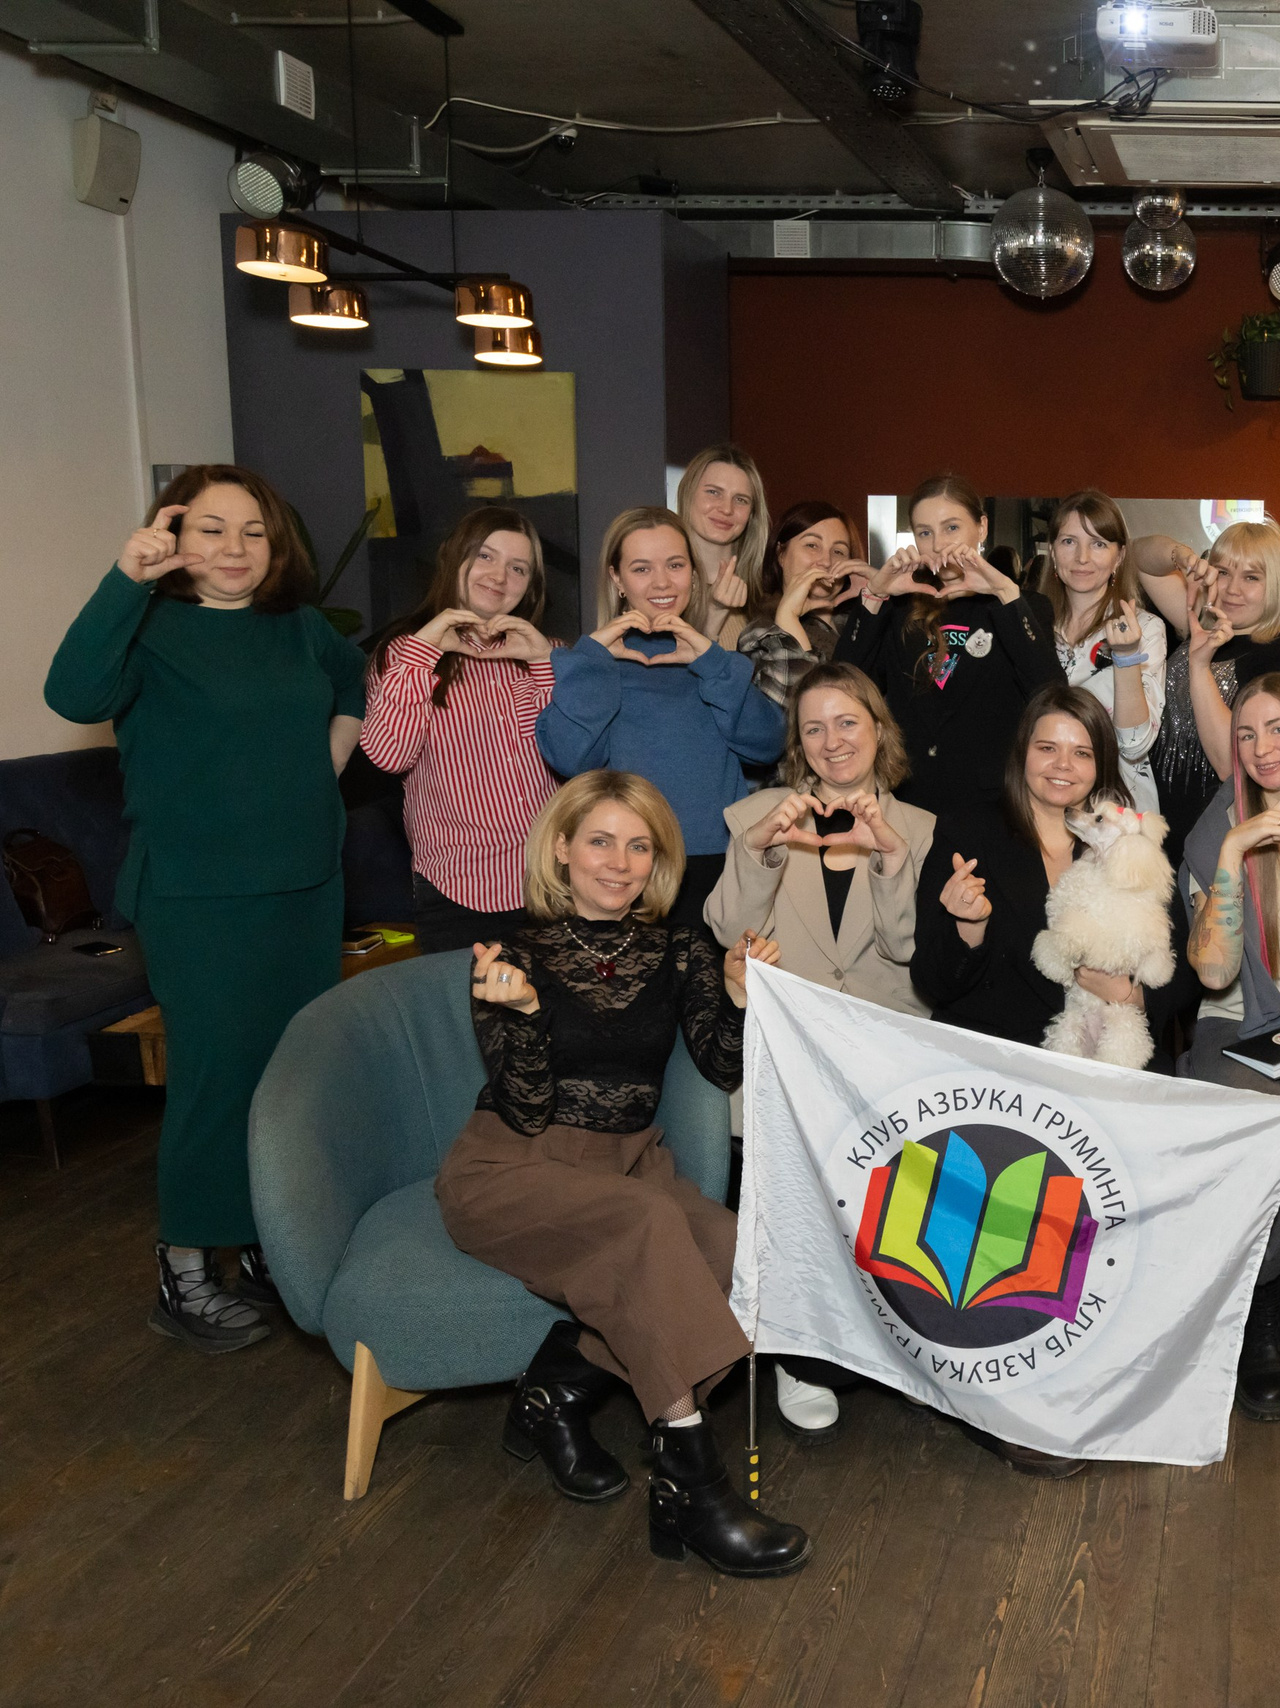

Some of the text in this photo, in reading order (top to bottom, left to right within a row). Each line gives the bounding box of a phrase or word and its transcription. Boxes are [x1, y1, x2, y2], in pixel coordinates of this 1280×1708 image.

[847, 1087, 1127, 1231] КЛУБ АЗБУКА ГРУМИНГА
[1045, 1292, 1107, 1358] КЛУБ
[931, 1347, 1036, 1384] АЗБУКА
